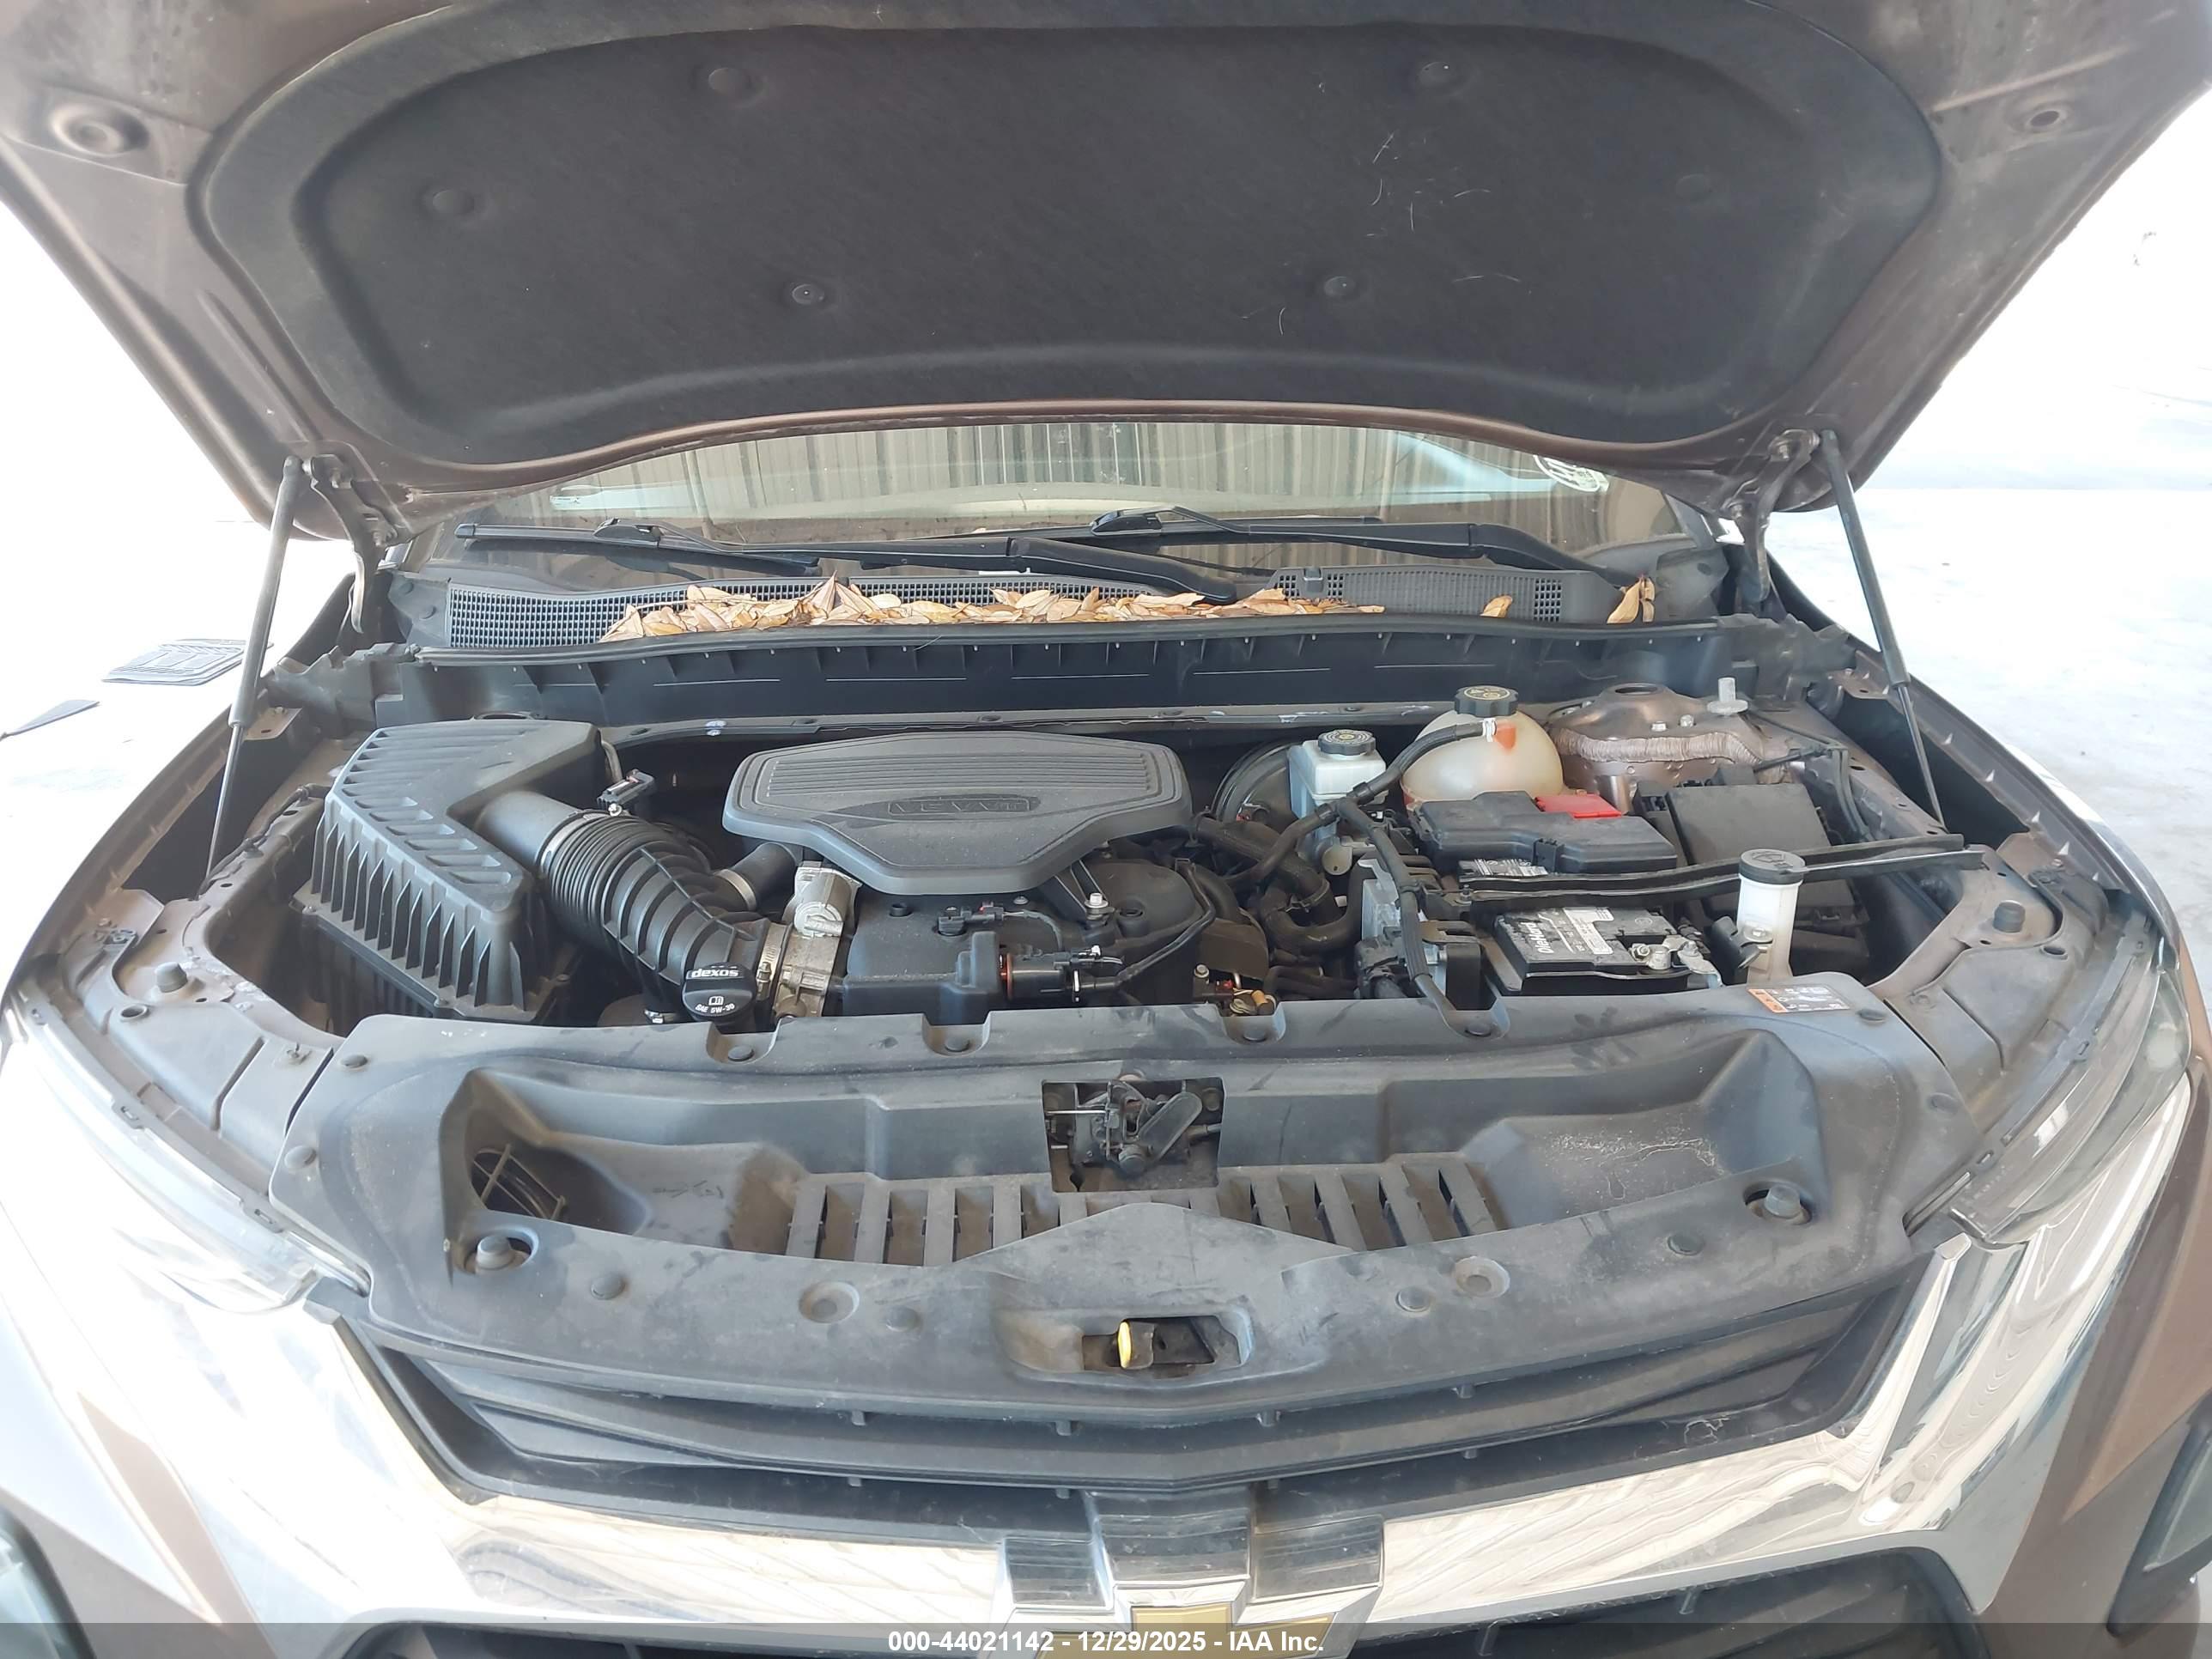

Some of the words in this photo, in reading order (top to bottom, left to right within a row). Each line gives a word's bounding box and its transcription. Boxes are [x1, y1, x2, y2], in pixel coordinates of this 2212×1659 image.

[691, 969, 739, 977] dexos
[696, 1004, 708, 1012] SAE
[711, 1004, 735, 1013] 5W-30
